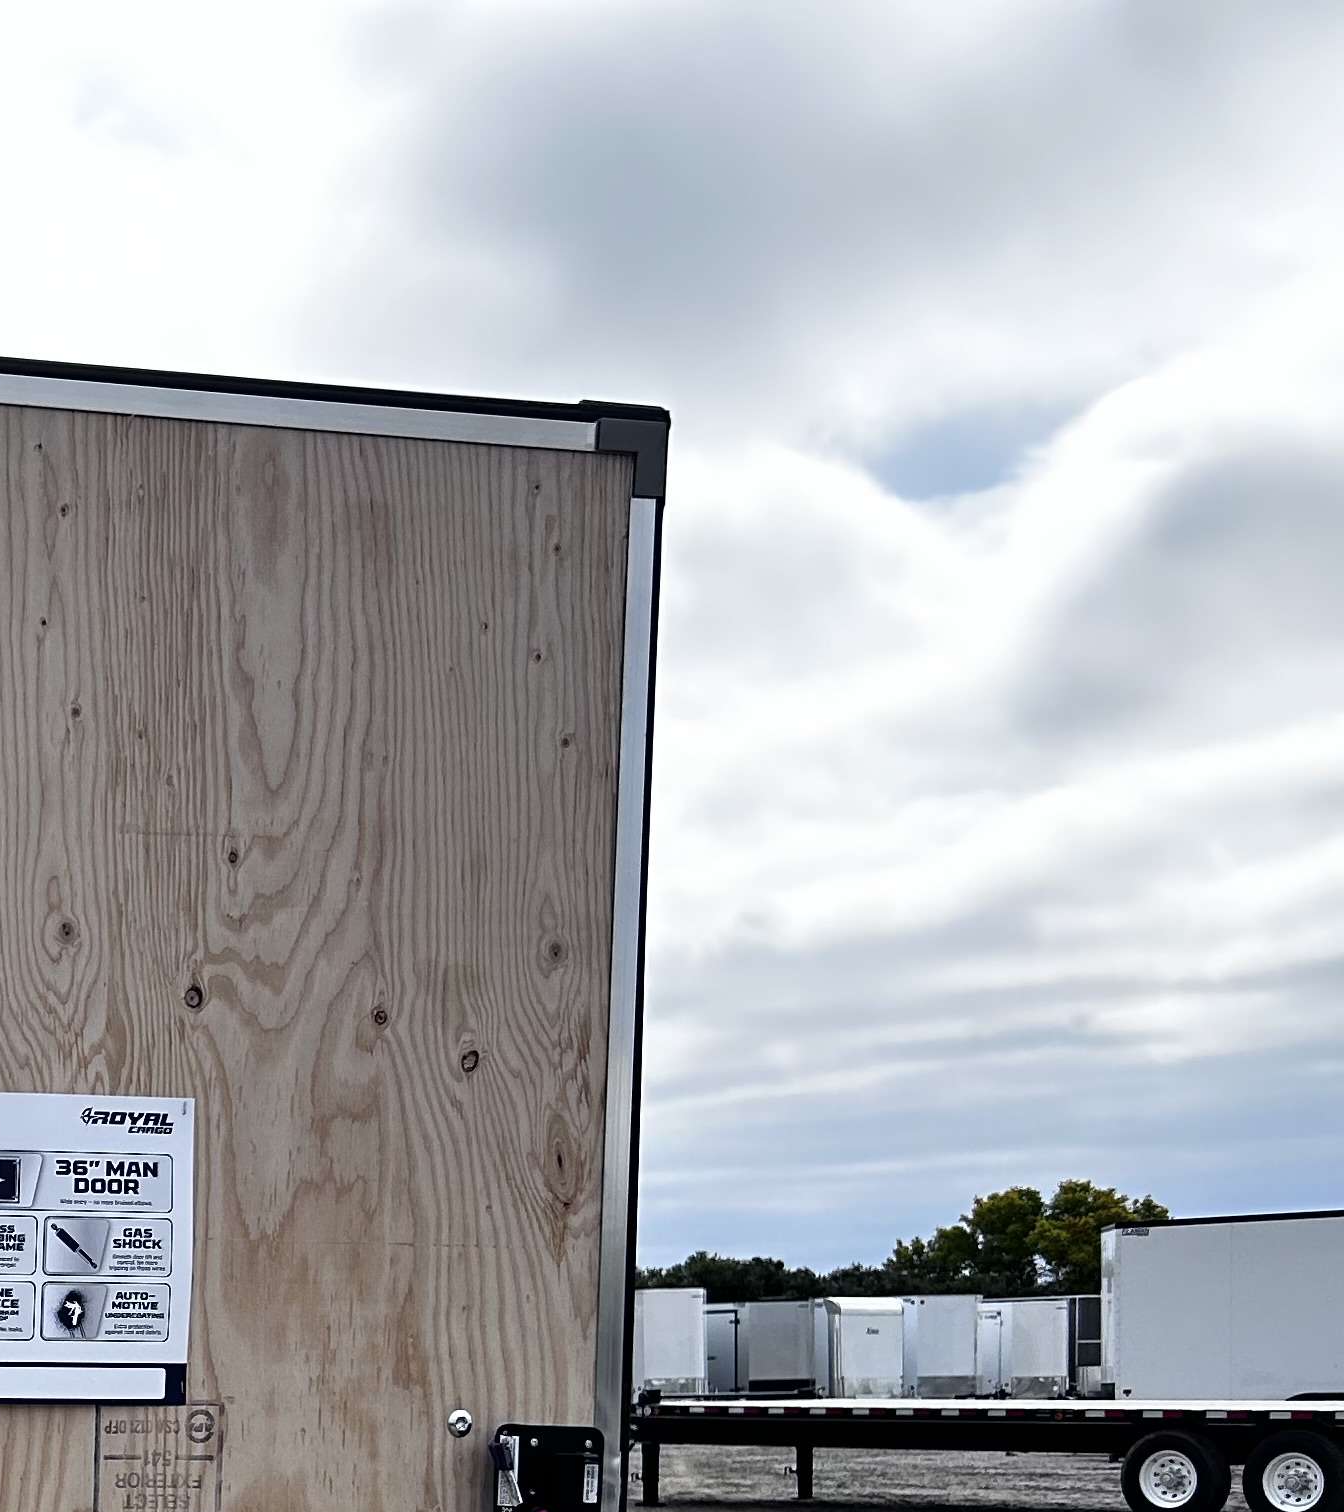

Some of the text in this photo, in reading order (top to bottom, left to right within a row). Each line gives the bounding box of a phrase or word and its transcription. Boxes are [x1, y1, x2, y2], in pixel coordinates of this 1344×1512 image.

[91, 1111, 174, 1126] ROYAL
[128, 1126, 173, 1134] CARGO
[105, 1161, 158, 1178] MAN
[74, 1178, 140, 1194] DOOR
[123, 1228, 153, 1238] GAS
[113, 1239, 162, 1249] SHOCK
[115, 1292, 156, 1300] AUTO-
[112, 1302, 159, 1310] MOTIVE
[143, 1450, 172, 1467] 541
[115, 1472, 203, 1489] EXTERIOR
[122, 1494, 190, 1510] SELECT
